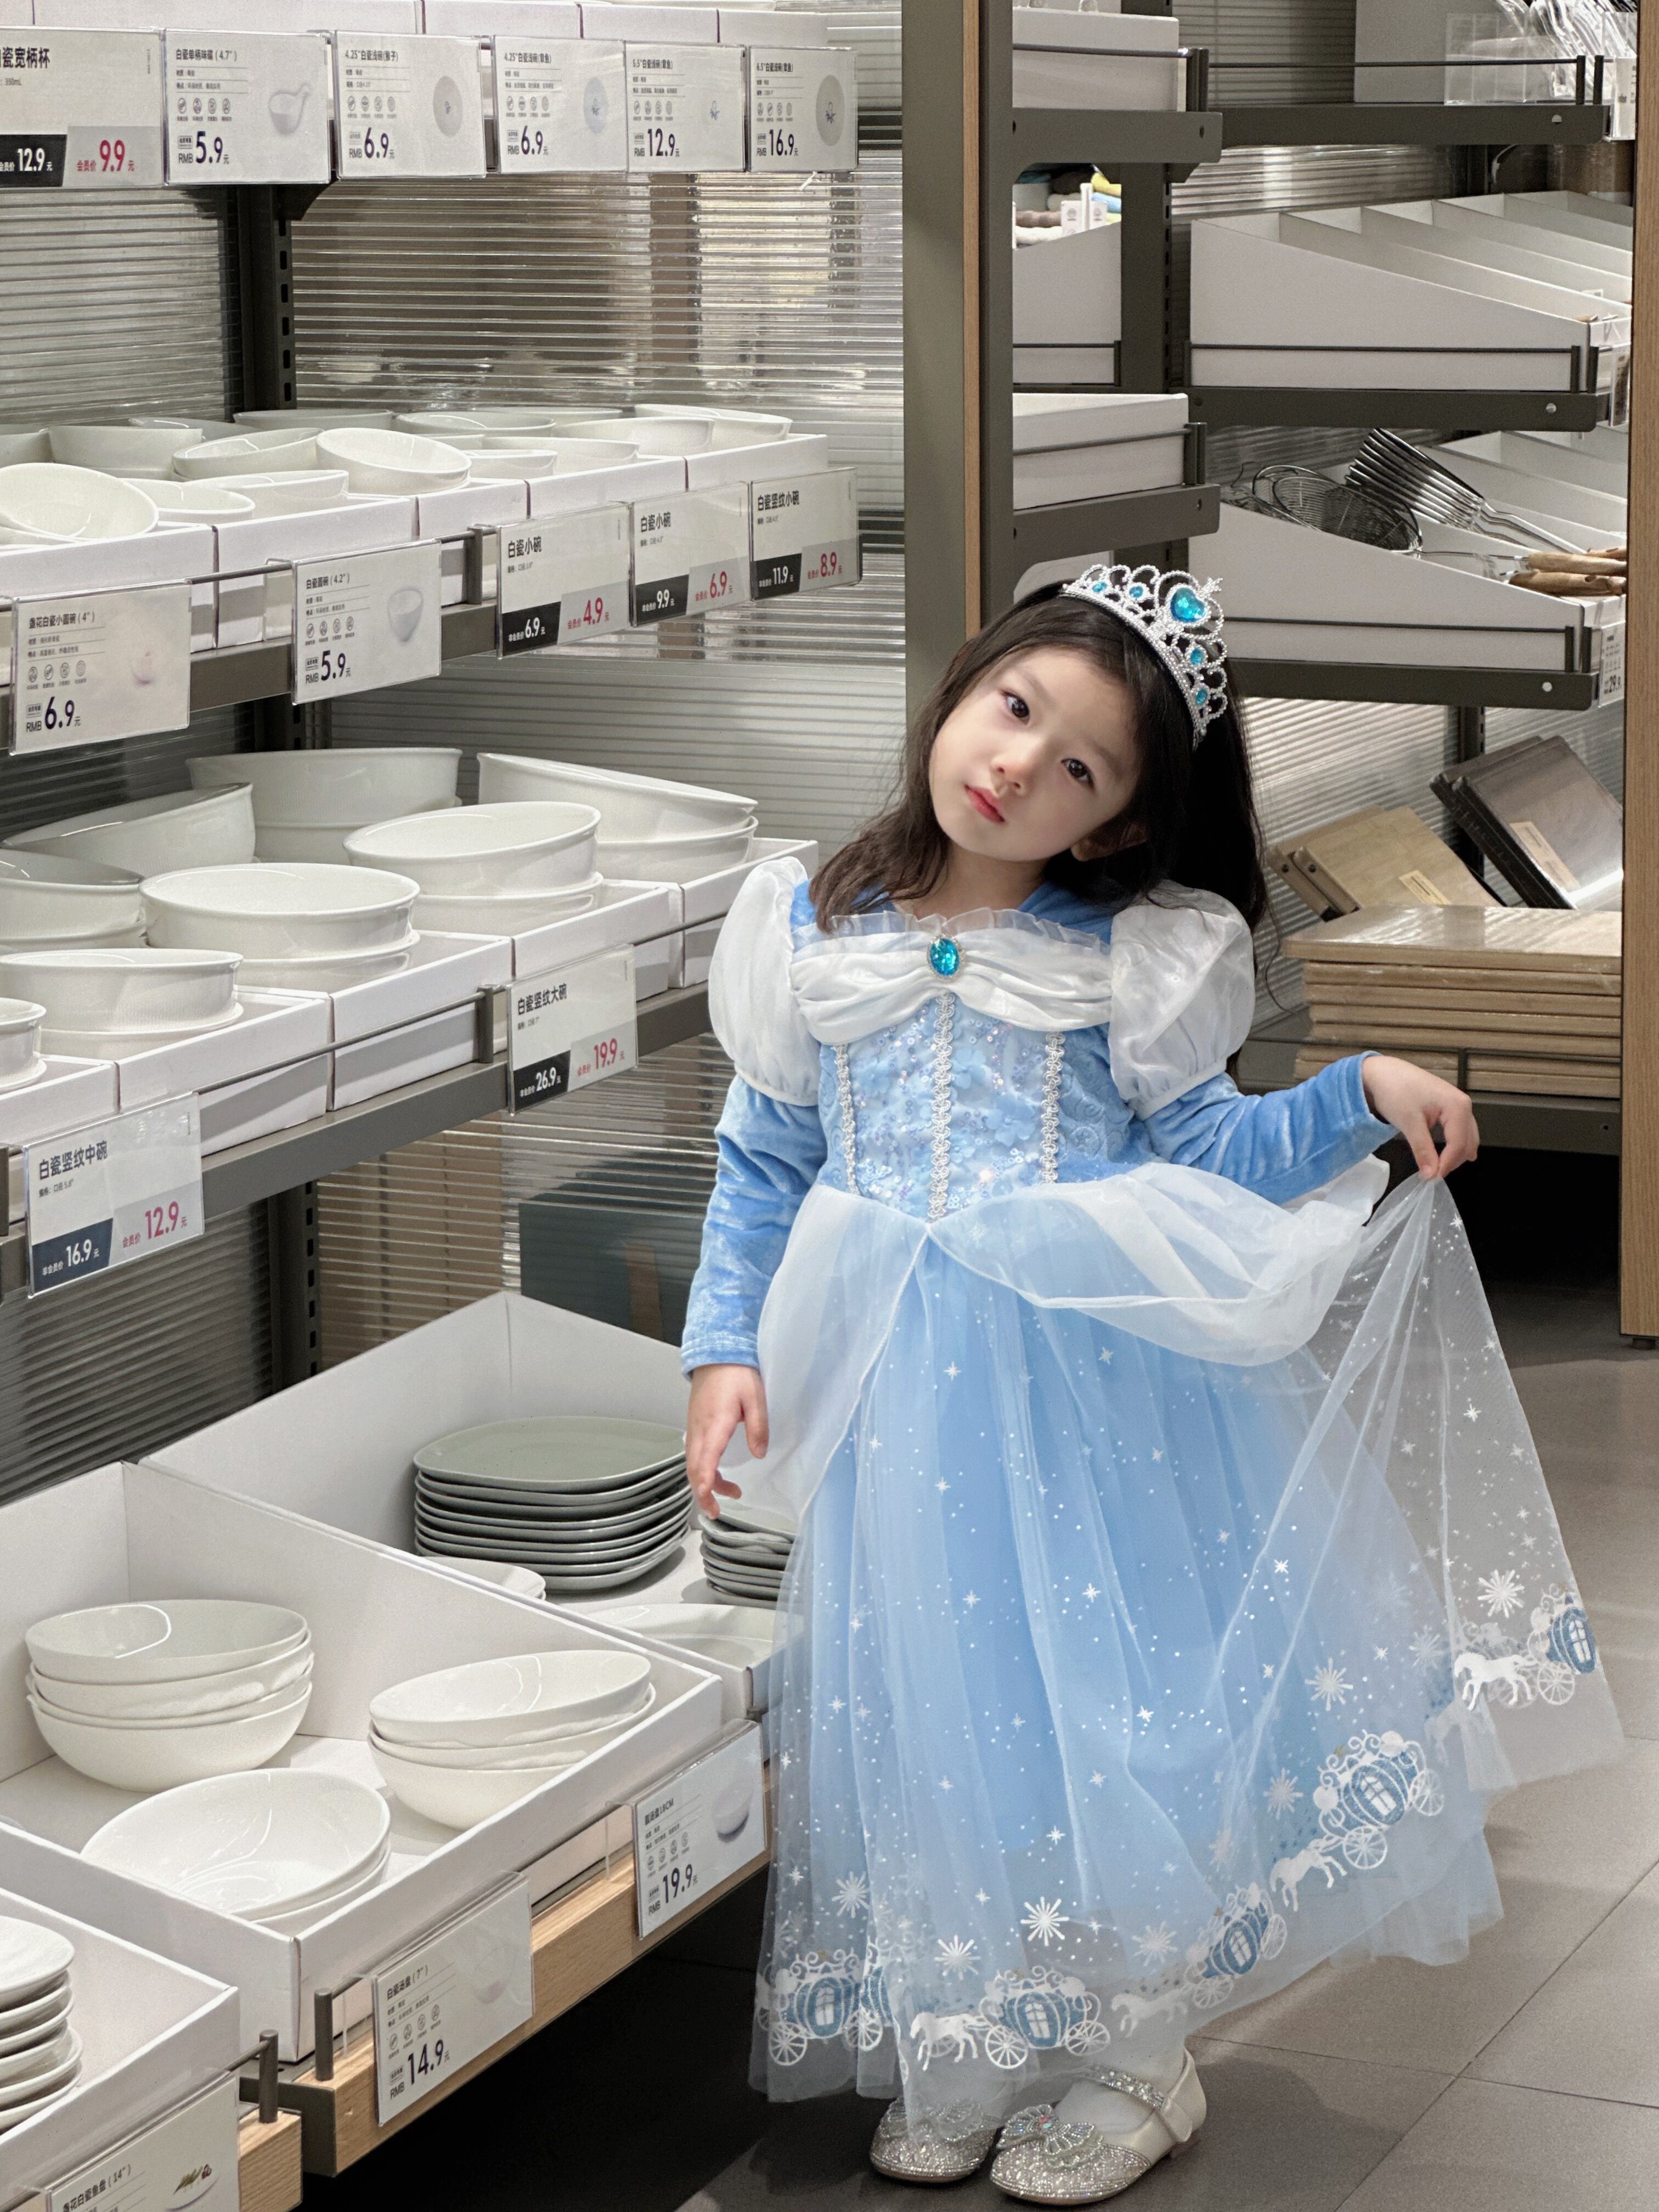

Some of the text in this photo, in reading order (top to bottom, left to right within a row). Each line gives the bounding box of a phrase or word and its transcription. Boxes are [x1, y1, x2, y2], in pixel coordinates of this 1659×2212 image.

[0, 47, 50, 69] 瓷宽柄杯
[77, 139, 134, 172] 会员价 9.9 元
[178, 131, 229, 164] RMB 5.9 元
[349, 148, 363, 159] RMB
[364, 127, 389, 159] 6.9
[389, 149, 395, 159] 元
[507, 145, 520, 155] RMB
[521, 125, 543, 155] 6.9
[543, 146, 549, 155] 元
[634, 148, 645, 157] RMB
[647, 128, 675, 157] 12.9
[675, 148, 680, 157] 元
[756, 147, 767, 156] RMB
[769, 128, 794, 156] 16.9
[18, 148, 46, 172] 12.9
[47, 162, 53, 171] 元
[641, 511, 671, 533] 白瓷小碗
[508, 535, 542, 558] 白瓷小碗
[773, 566, 788, 585] 11.9
[821, 551, 837, 577] 8.9
[657, 589, 670, 609] 9.9
[709, 571, 727, 599] 6.9
[525, 617, 540, 639] 6.9
[540, 627, 546, 635] 元
[567, 597, 610, 629] 会员价 4.9 元
[306, 650, 351, 685] RMB 5.9 元
[26, 696, 81, 733] RMB 6.9 元
[517, 983, 567, 1015] 白瓷竖纹大碗
[594, 1037, 618, 1070] 19.9
[619, 1051, 625, 1060] 元
[536, 1066, 556, 1092] 26.9
[39, 1139, 108, 1181] 白瓷竖纹中碗
[122, 1201, 187, 1249] 会员价 12.9 元
[42, 1239, 100, 1276] 非会员价 16.9 元
[648, 1902, 661, 1916] RMB
[662, 1864, 693, 1904] 19.9
[692, 1875, 698, 1886] 元
[390, 2082, 405, 2100] RMB
[408, 2038, 445, 2086] 14.9
[444, 2050, 450, 2063] 元
